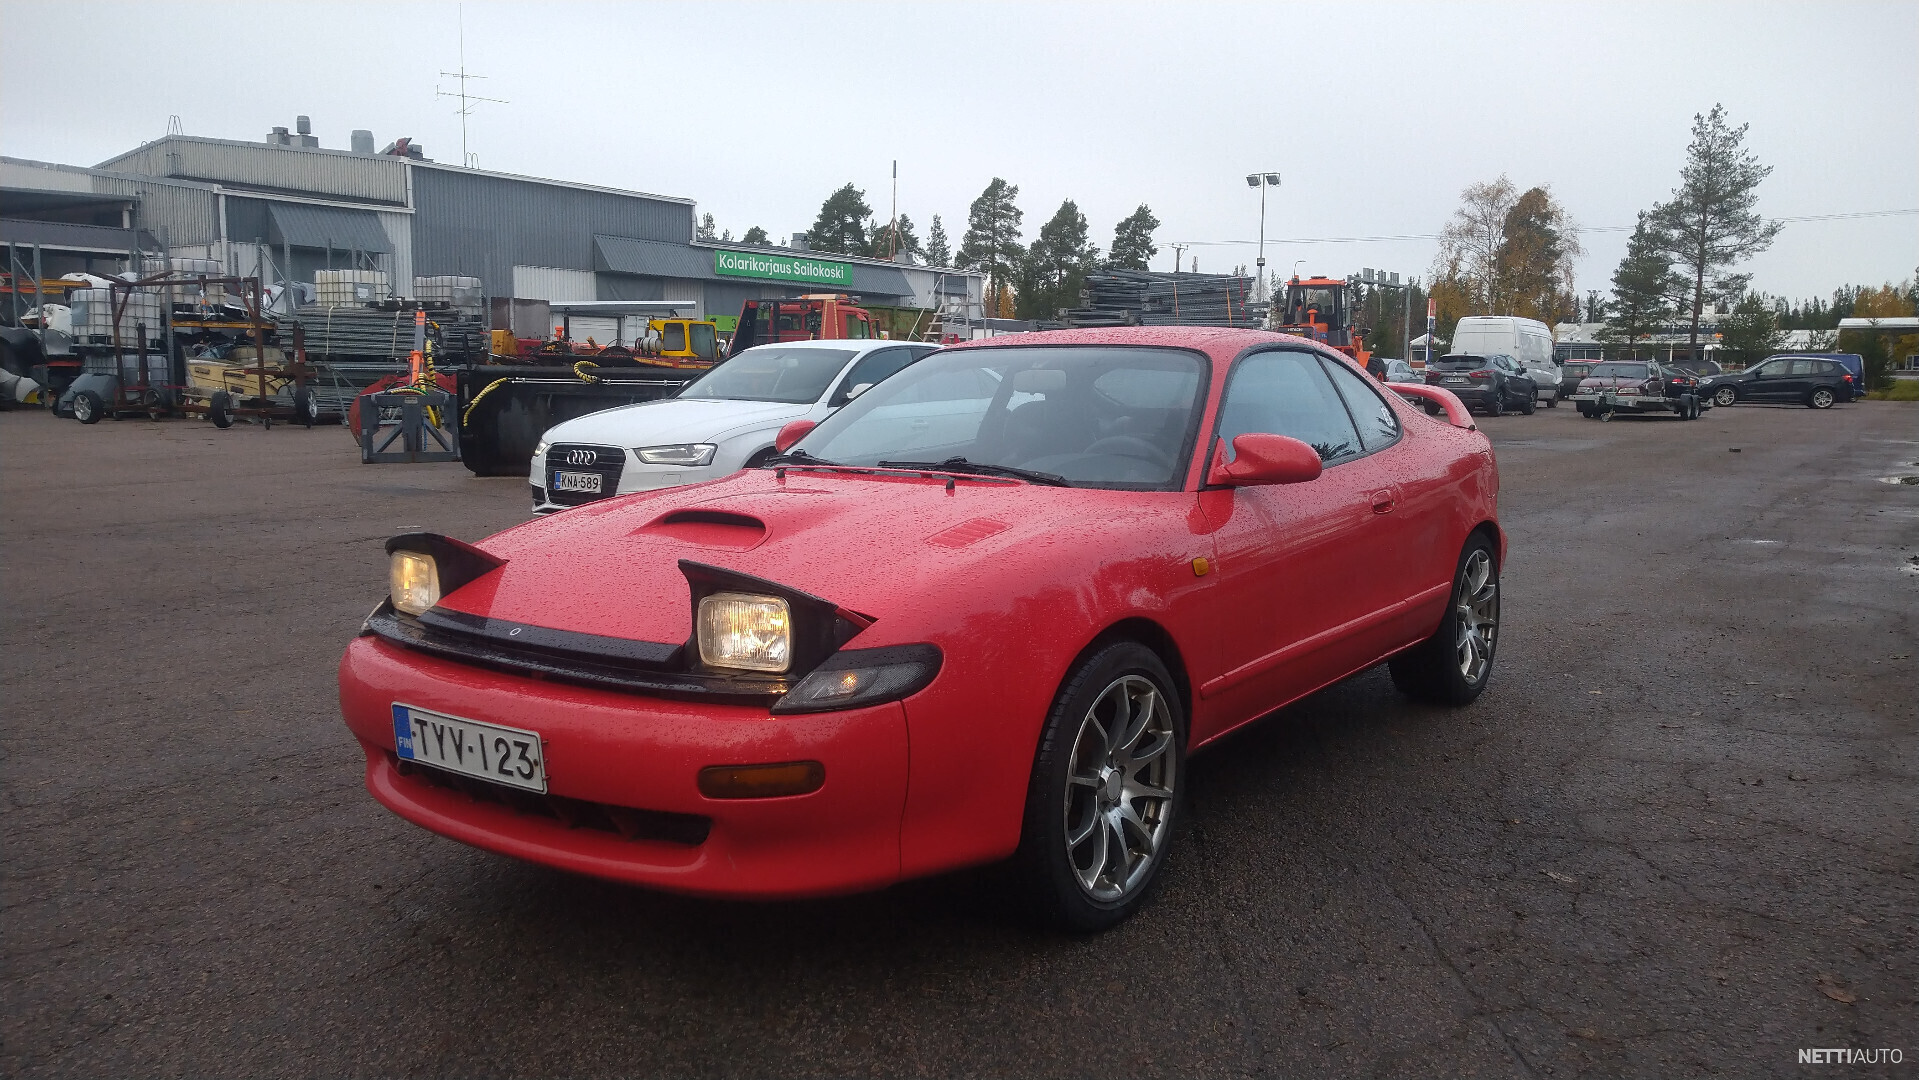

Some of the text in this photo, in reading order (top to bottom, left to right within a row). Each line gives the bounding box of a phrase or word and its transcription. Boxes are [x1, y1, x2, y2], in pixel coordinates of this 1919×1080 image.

[719, 254, 844, 279] Kolarikorjaus Sailokoski
[731, 318, 737, 329] 3
[561, 474, 599, 490] KNA-589
[398, 736, 413, 749] FIN
[414, 717, 535, 780] TYV-123
